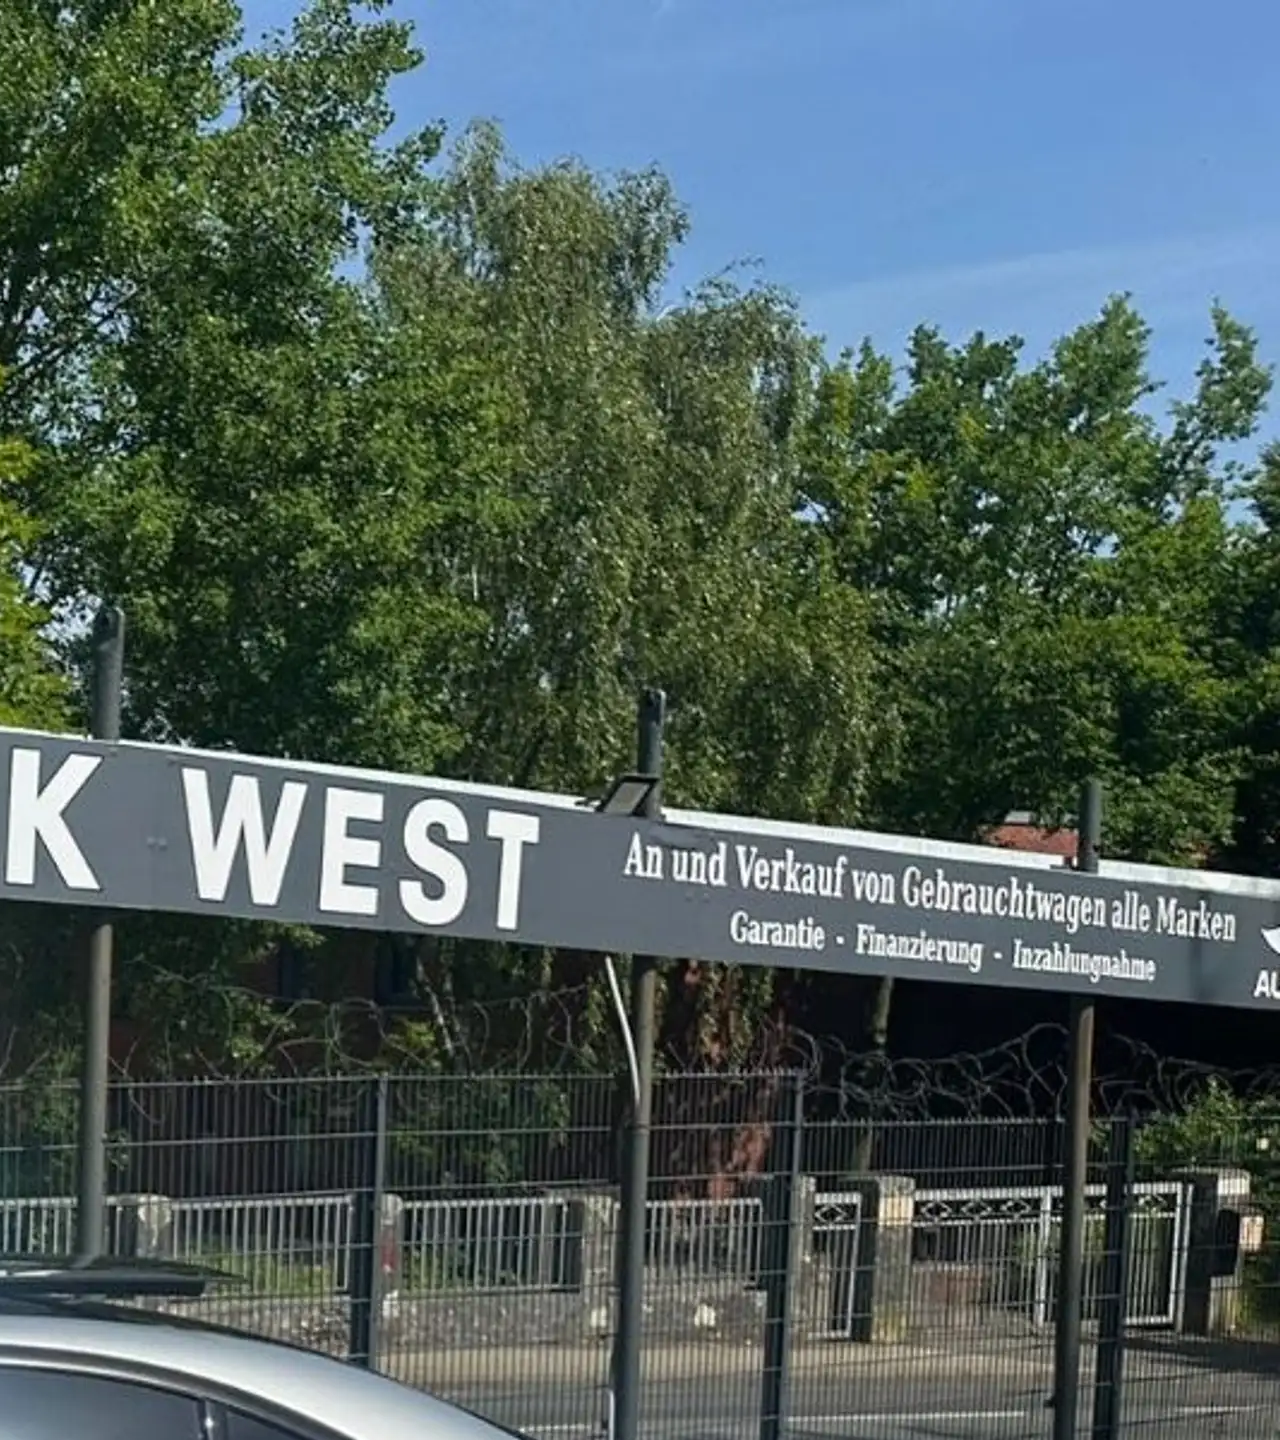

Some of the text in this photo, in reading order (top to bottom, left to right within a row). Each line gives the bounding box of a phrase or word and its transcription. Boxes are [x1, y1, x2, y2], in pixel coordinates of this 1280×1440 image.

[181, 766, 541, 931] WEST
[623, 831, 1237, 942] An und Verkauf von Gebrauchtwagen alle Marken
[729, 910, 827, 951] Garantie
[855, 923, 986, 973] Finanzierung
[1012, 938, 1158, 984] Inzahlungnahme
